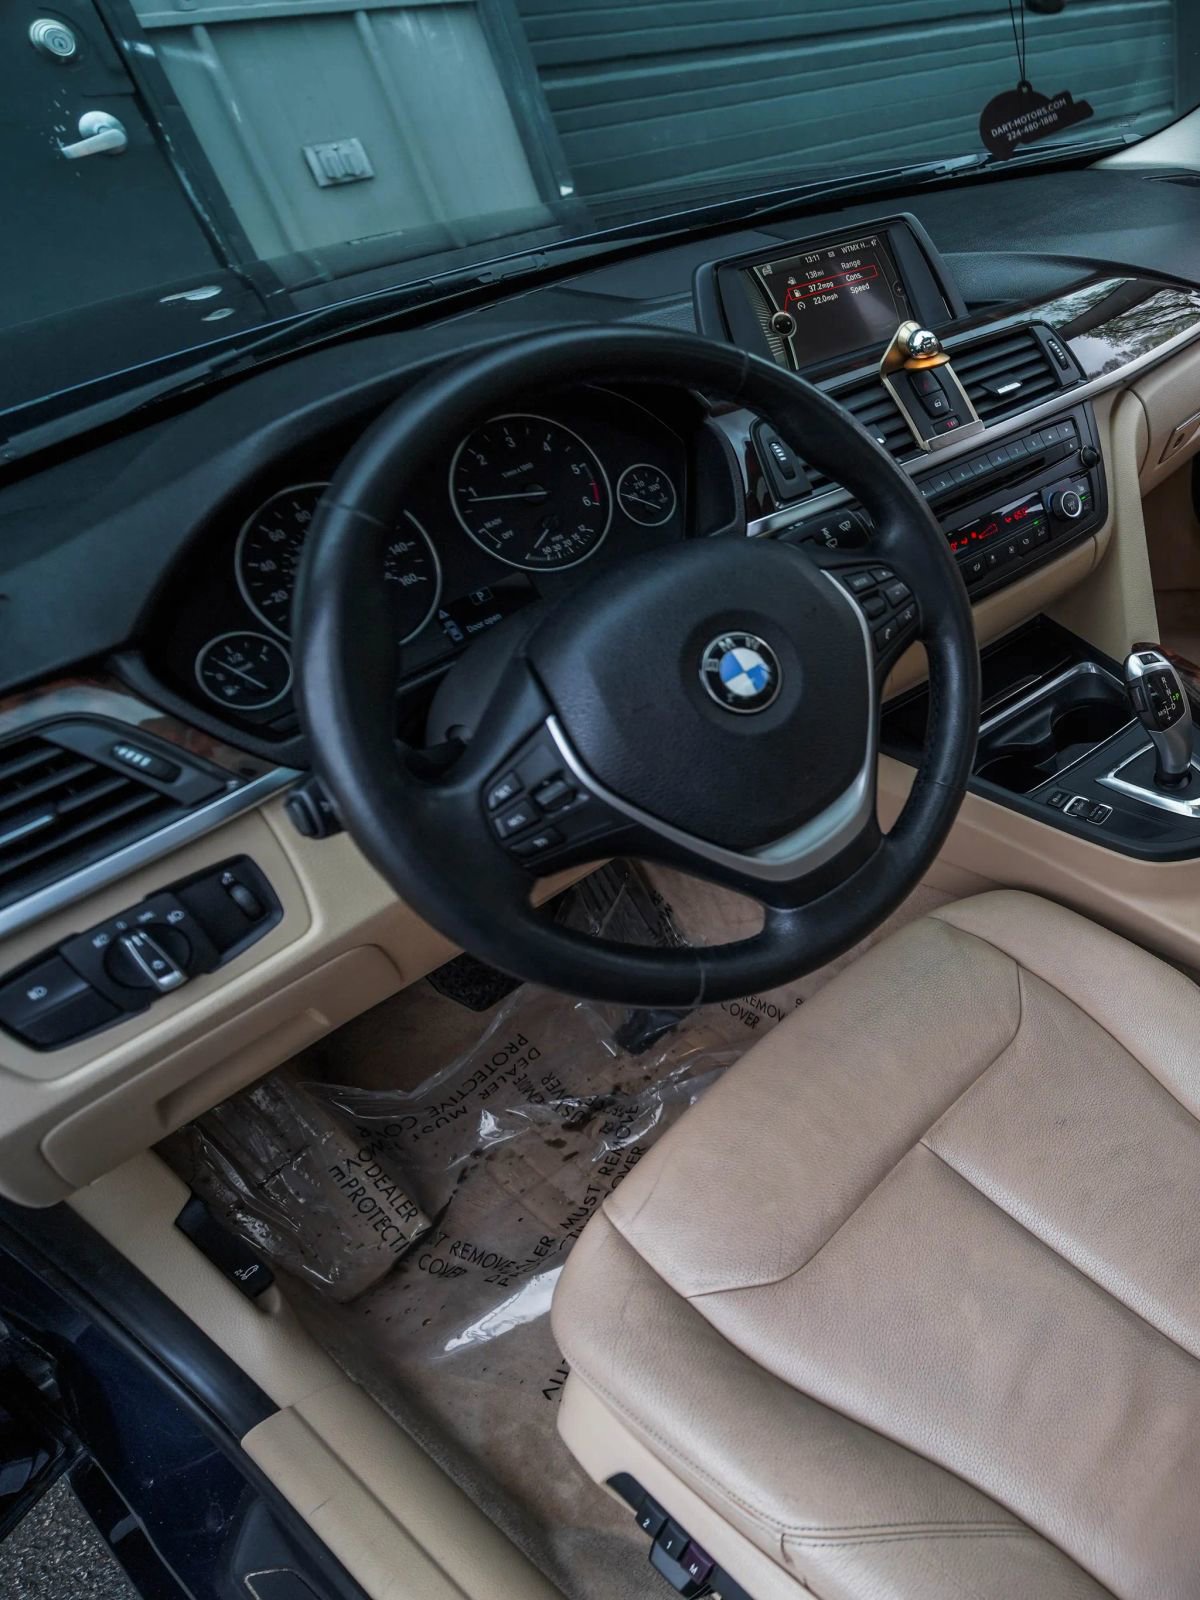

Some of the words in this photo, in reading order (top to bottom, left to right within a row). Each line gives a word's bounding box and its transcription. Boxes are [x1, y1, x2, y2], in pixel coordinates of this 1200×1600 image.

[991, 98, 1067, 137] DART-MOTORS.COM
[805, 255, 821, 264] 13:11
[841, 243, 861, 255] WTMX
[841, 259, 862, 270] Range
[846, 272, 864, 282] Cons.
[850, 282, 871, 294] Speed
[506, 436, 516, 448] 3
[543, 441, 552, 452] 4
[476, 453, 489, 466] 2
[571, 463, 581, 475] 5
[582, 496, 592, 508] 6
[389, 543, 409, 556] 140
[400, 572, 419, 587] 160
[271, 590, 289, 603] 20
[424, 1033, 528, 1119] PROTECTIVE
[479, 1047, 541, 1100] DEALER
[365, 1164, 419, 1223] DEALER
[560, 1184, 602, 1230] MUST
[642, 1518, 650, 1528] 2
[689, 1563, 697, 1575] M
